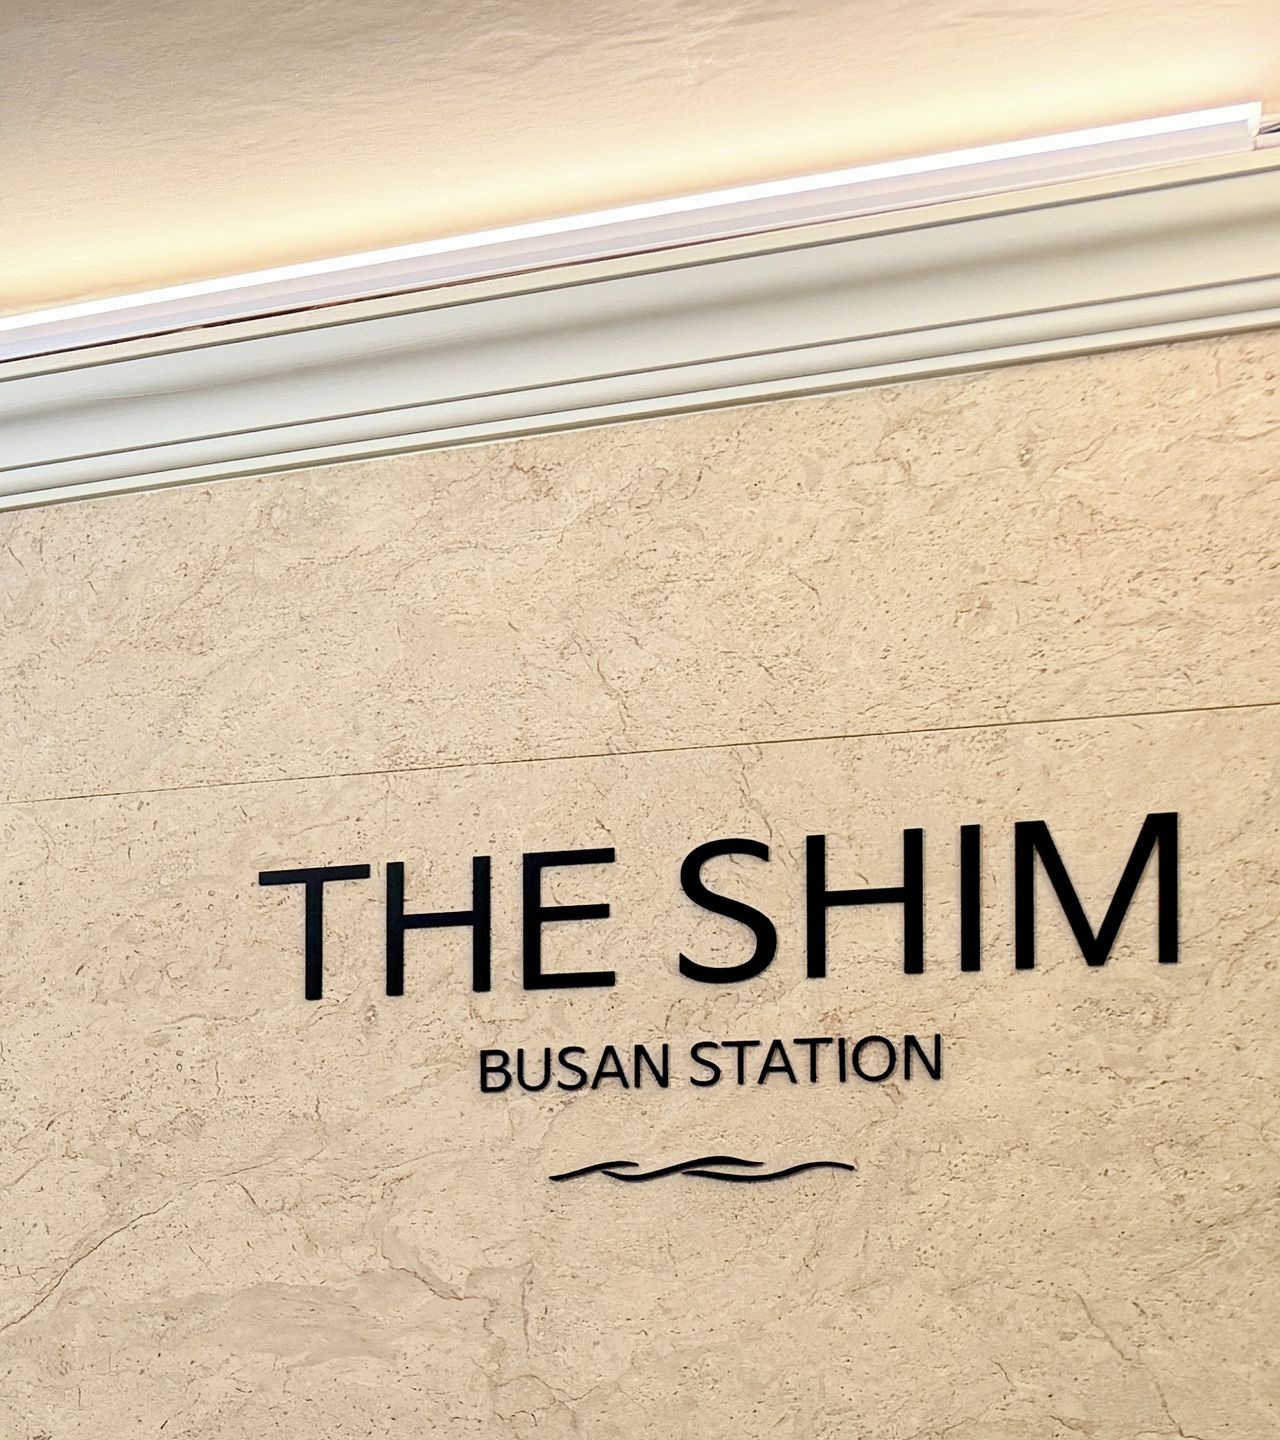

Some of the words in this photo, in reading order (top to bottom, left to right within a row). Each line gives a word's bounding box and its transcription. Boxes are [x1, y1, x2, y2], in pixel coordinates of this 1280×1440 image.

[258, 847, 616, 1001] THE
[678, 811, 1180, 985] SHIM
[479, 1043, 669, 1094] BUSAN
[690, 1033, 943, 1088] STATION
